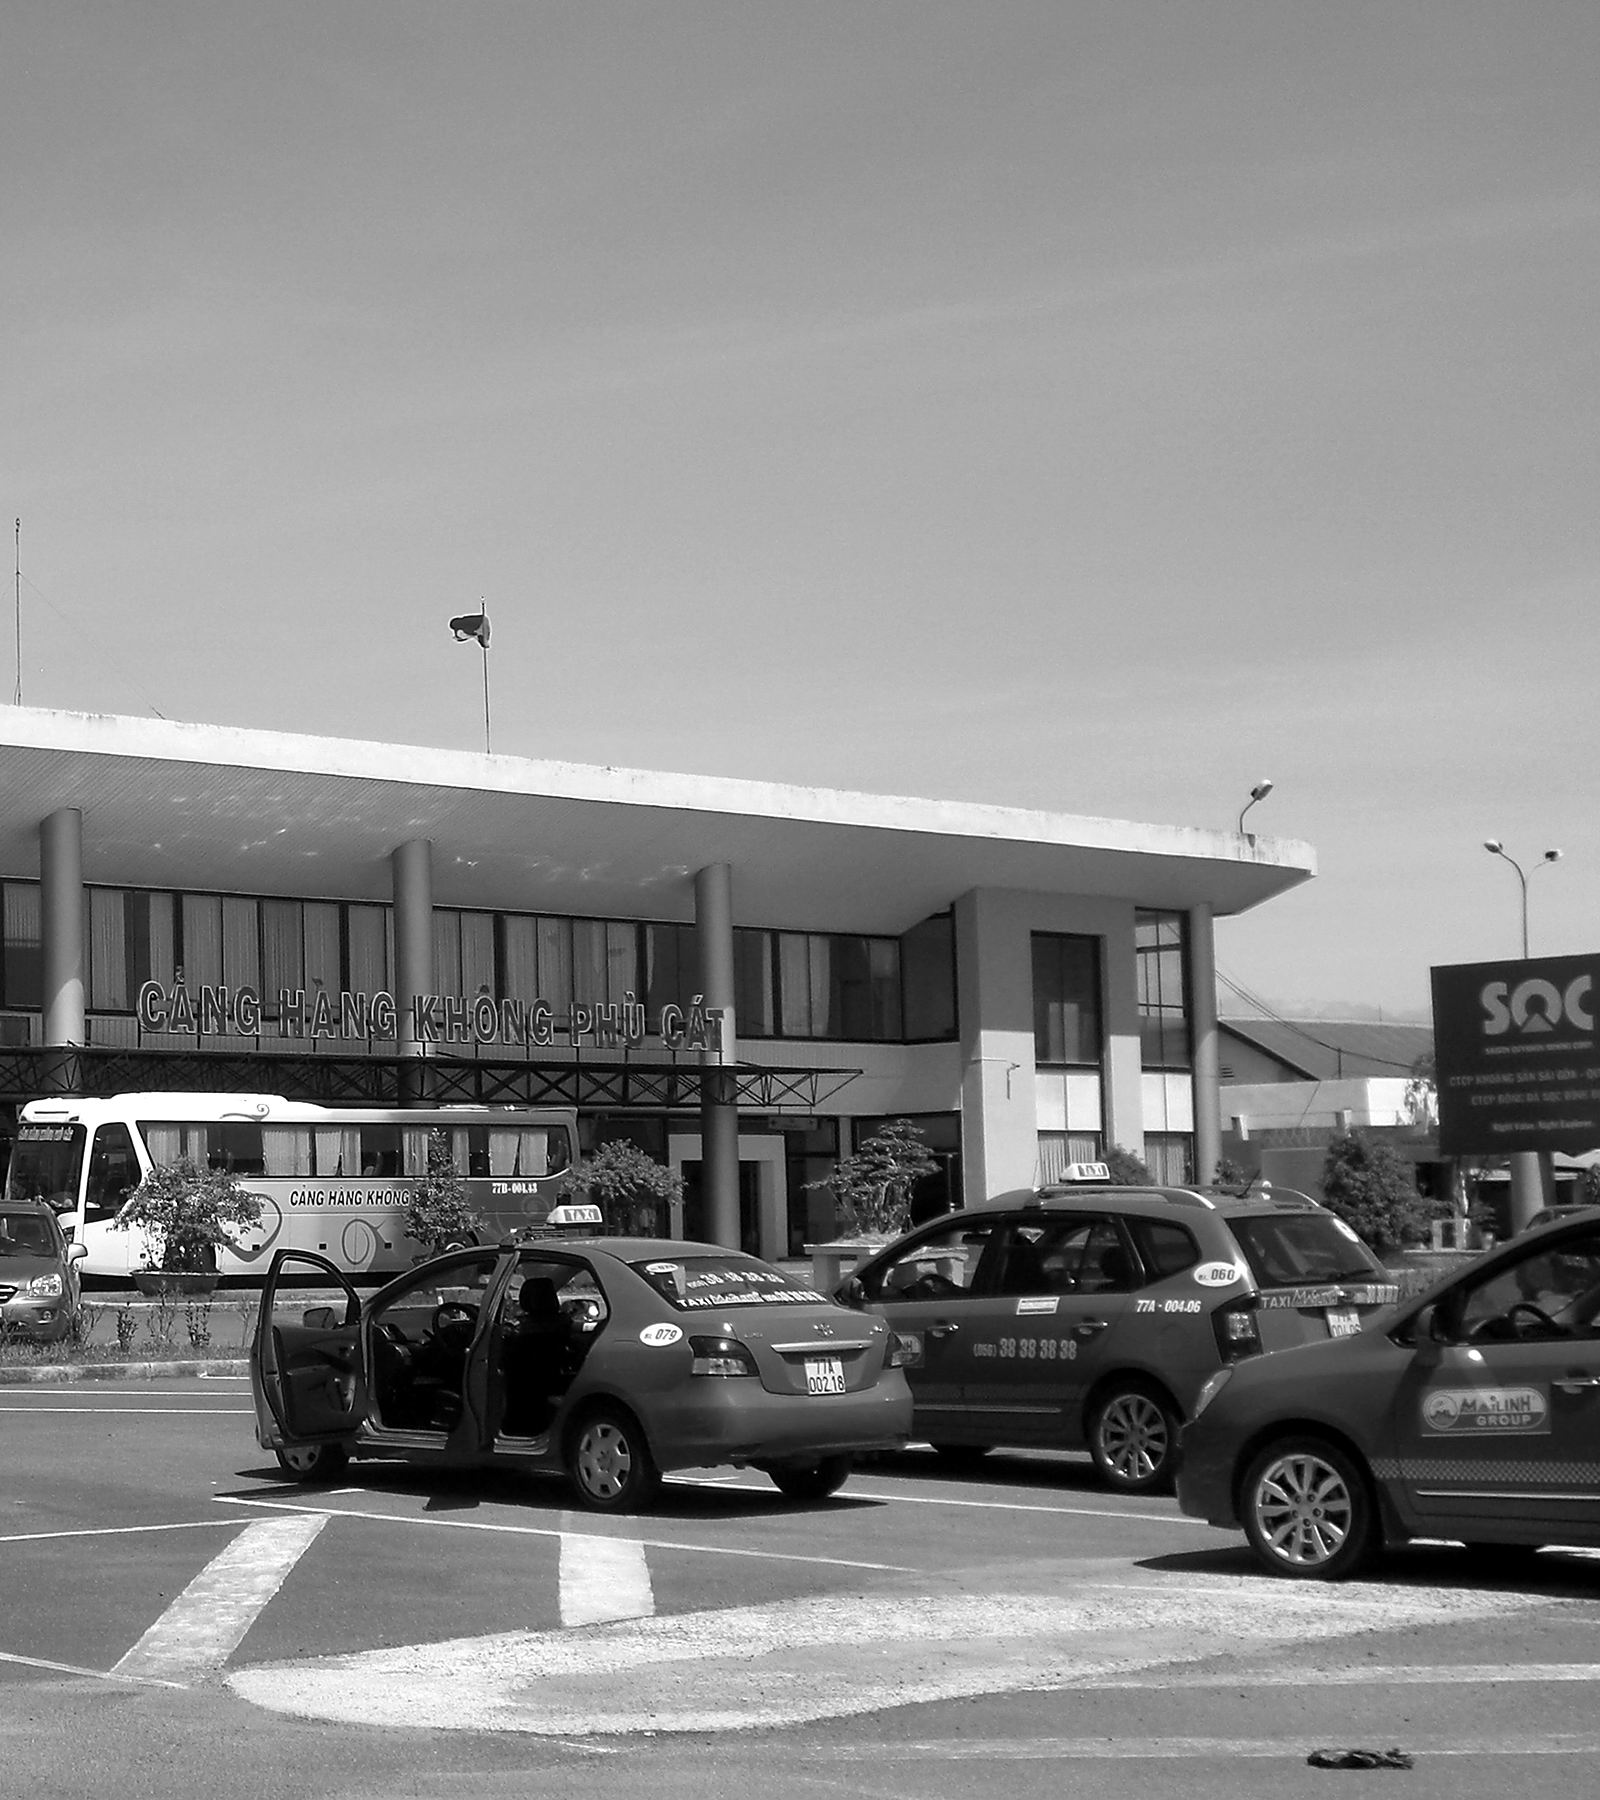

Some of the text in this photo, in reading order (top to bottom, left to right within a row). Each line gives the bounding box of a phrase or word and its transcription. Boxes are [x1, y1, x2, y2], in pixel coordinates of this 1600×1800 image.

[139, 967, 260, 1036] CẢNG
[279, 976, 398, 1040] HÀNG
[413, 985, 553, 1046] KHÔNG
[661, 995, 725, 1051] CÁT
[1211, 1268, 1235, 1281] 060
[676, 1297, 712, 1308] TAXI
[1261, 1296, 1291, 1309] TAXI
[655, 1328, 677, 1341] 079
[999, 1338, 1016, 1358] 38
[1019, 1338, 1037, 1358] 38
[1039, 1339, 1057, 1359] 38
[1060, 1339, 1077, 1360] 38
[814, 1358, 835, 1374] 77A
[1476, 1415, 1532, 1426] GROUP
